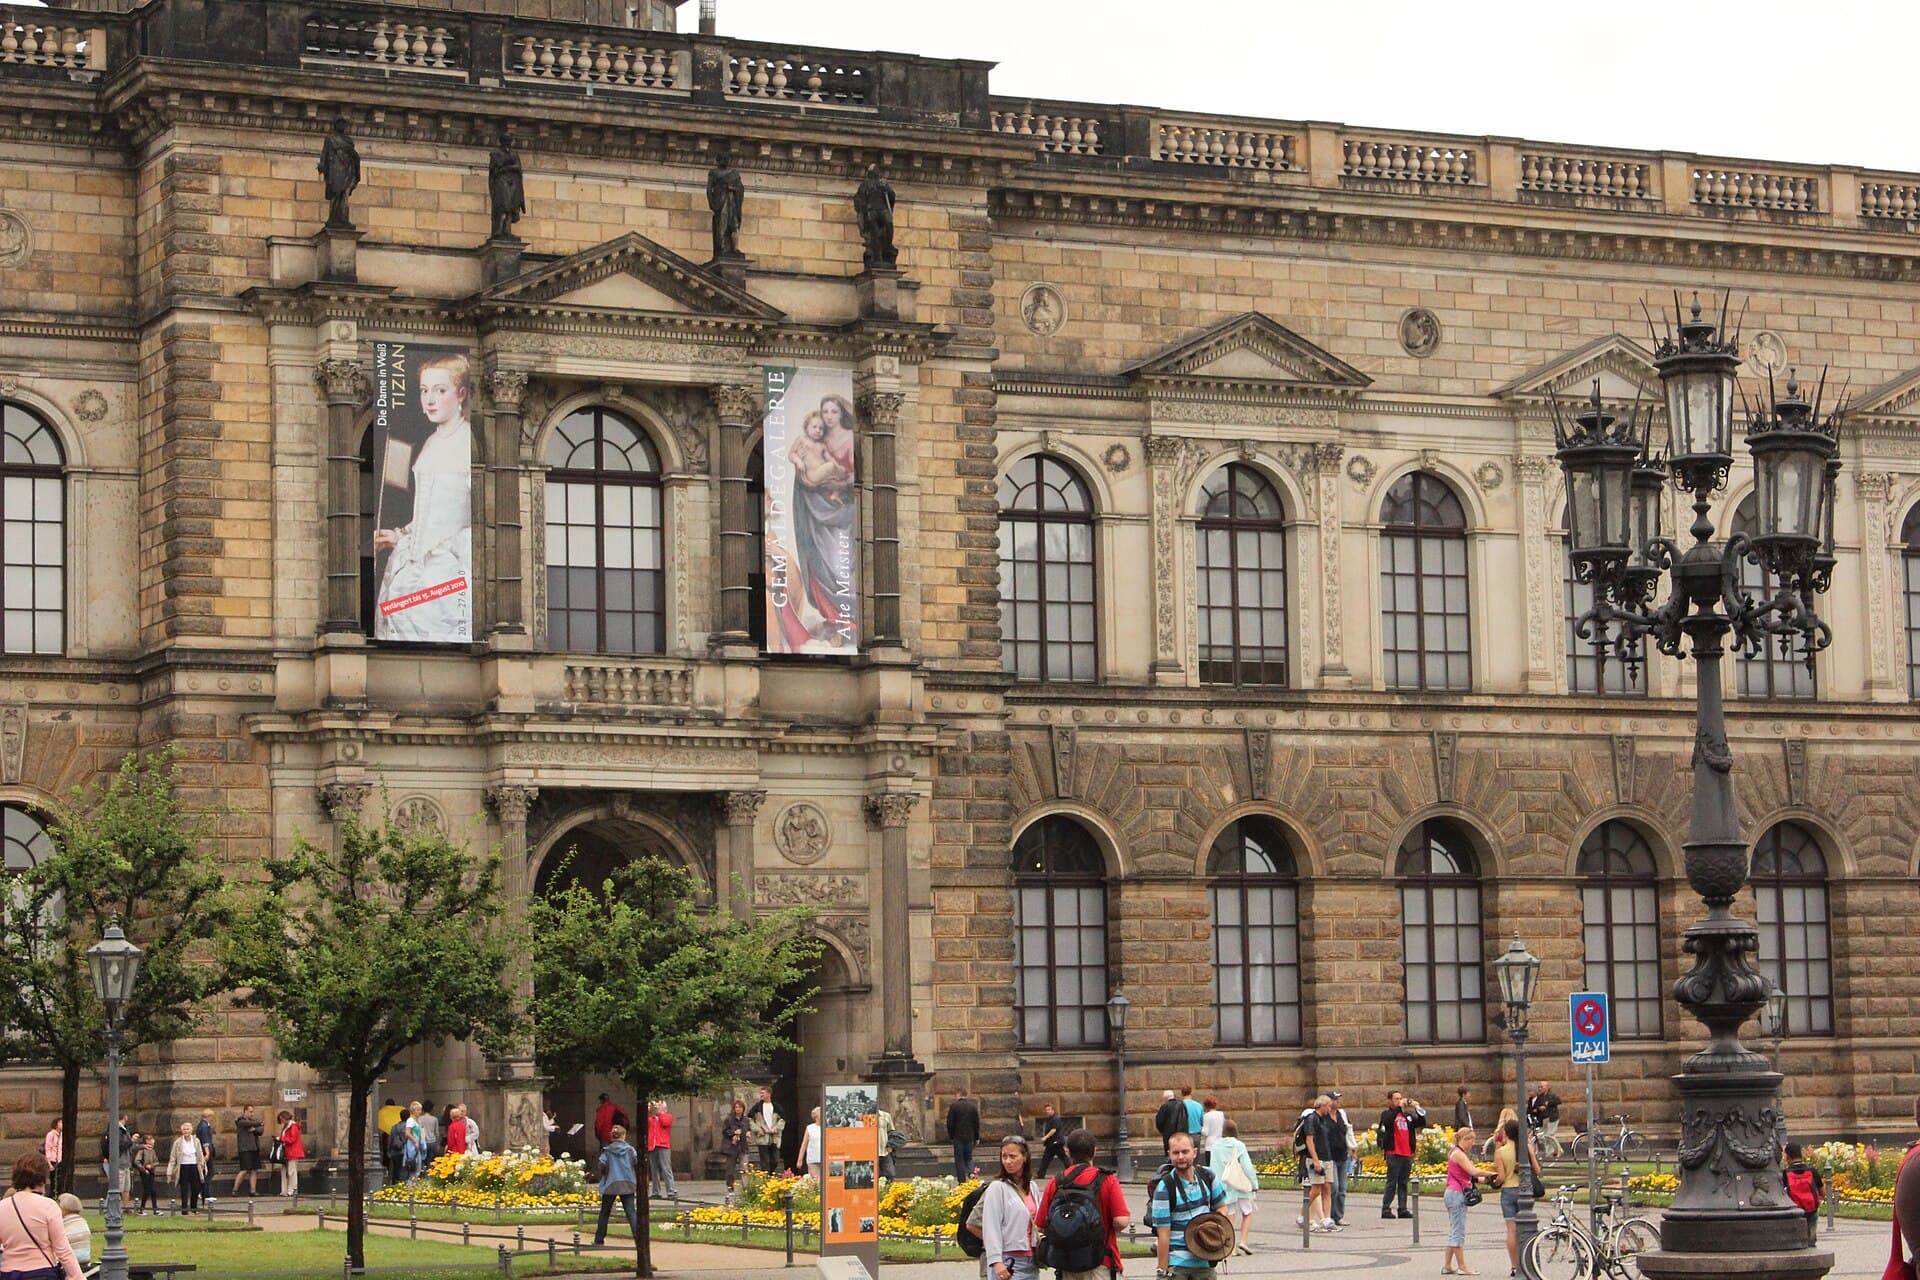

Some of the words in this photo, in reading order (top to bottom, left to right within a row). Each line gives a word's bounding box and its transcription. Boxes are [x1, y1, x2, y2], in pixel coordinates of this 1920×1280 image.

[377, 343, 387, 368] Weiß
[378, 369, 387, 378] in
[392, 344, 405, 409] TIZIAN
[377, 380, 387, 407] Dame
[377, 410, 387, 426] Die
[768, 372, 788, 608] GEMÄLDEGALERIE
[836, 532, 850, 597] Meister
[430, 584, 450, 597] August
[836, 604, 851, 640] Alte
[1575, 1041, 1605, 1056] TAXI
